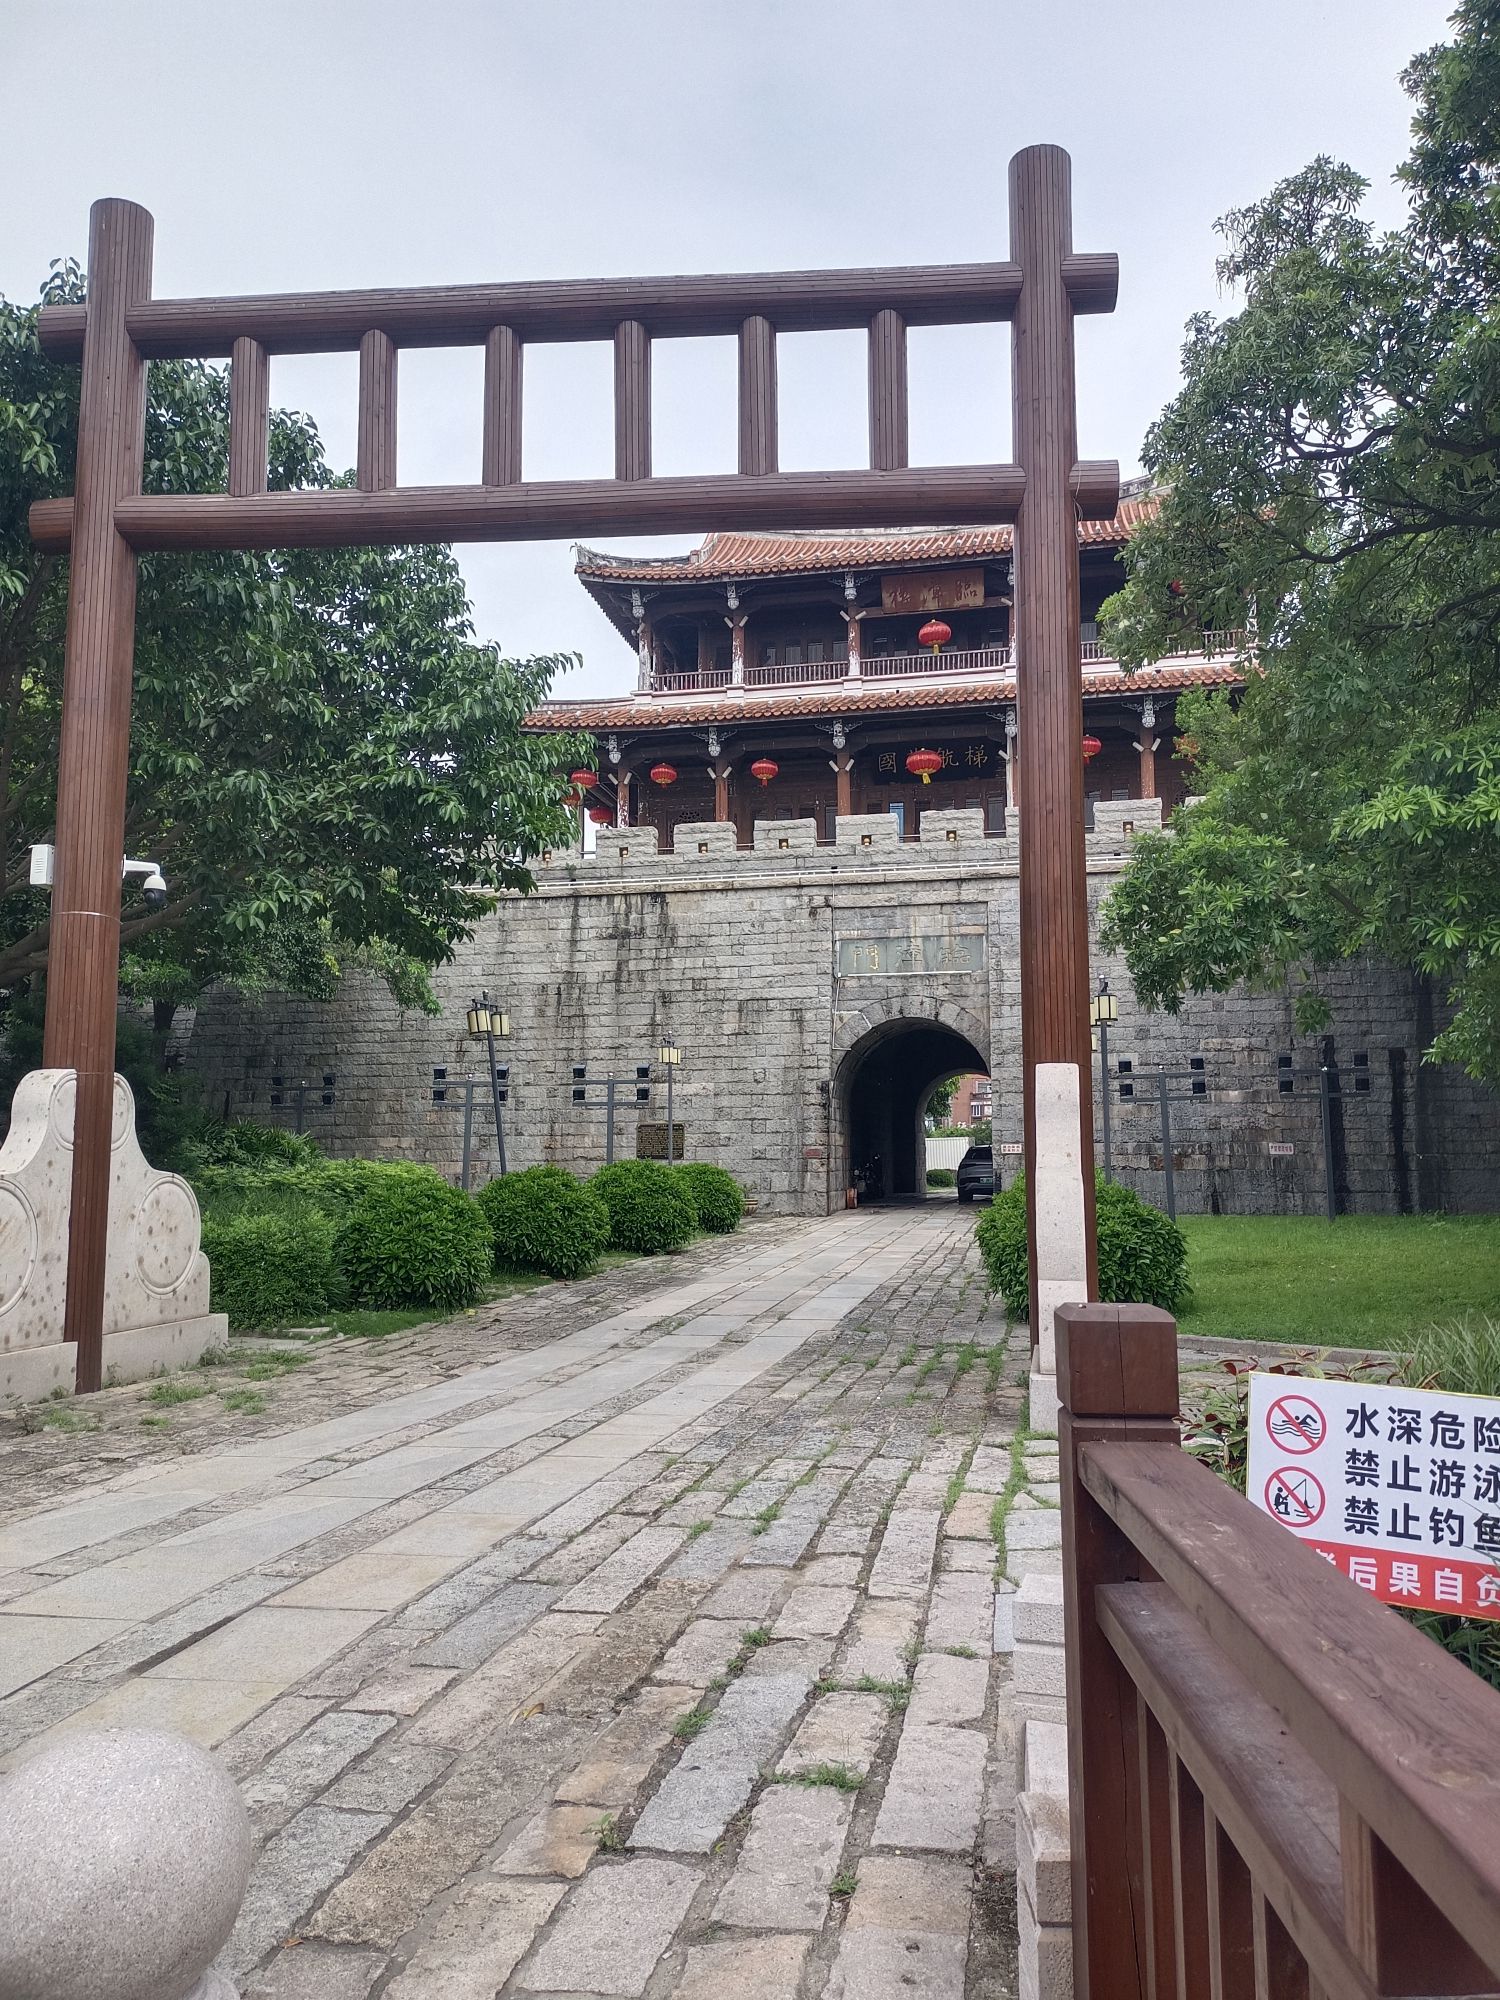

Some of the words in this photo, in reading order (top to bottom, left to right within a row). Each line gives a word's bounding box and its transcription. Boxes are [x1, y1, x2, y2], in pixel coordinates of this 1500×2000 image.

[1345, 1402, 1500, 1454] 水深危险
[1344, 1448, 1500, 1504] 禁止游泳
[1344, 1495, 1500, 1551] 禁止钓鱼
